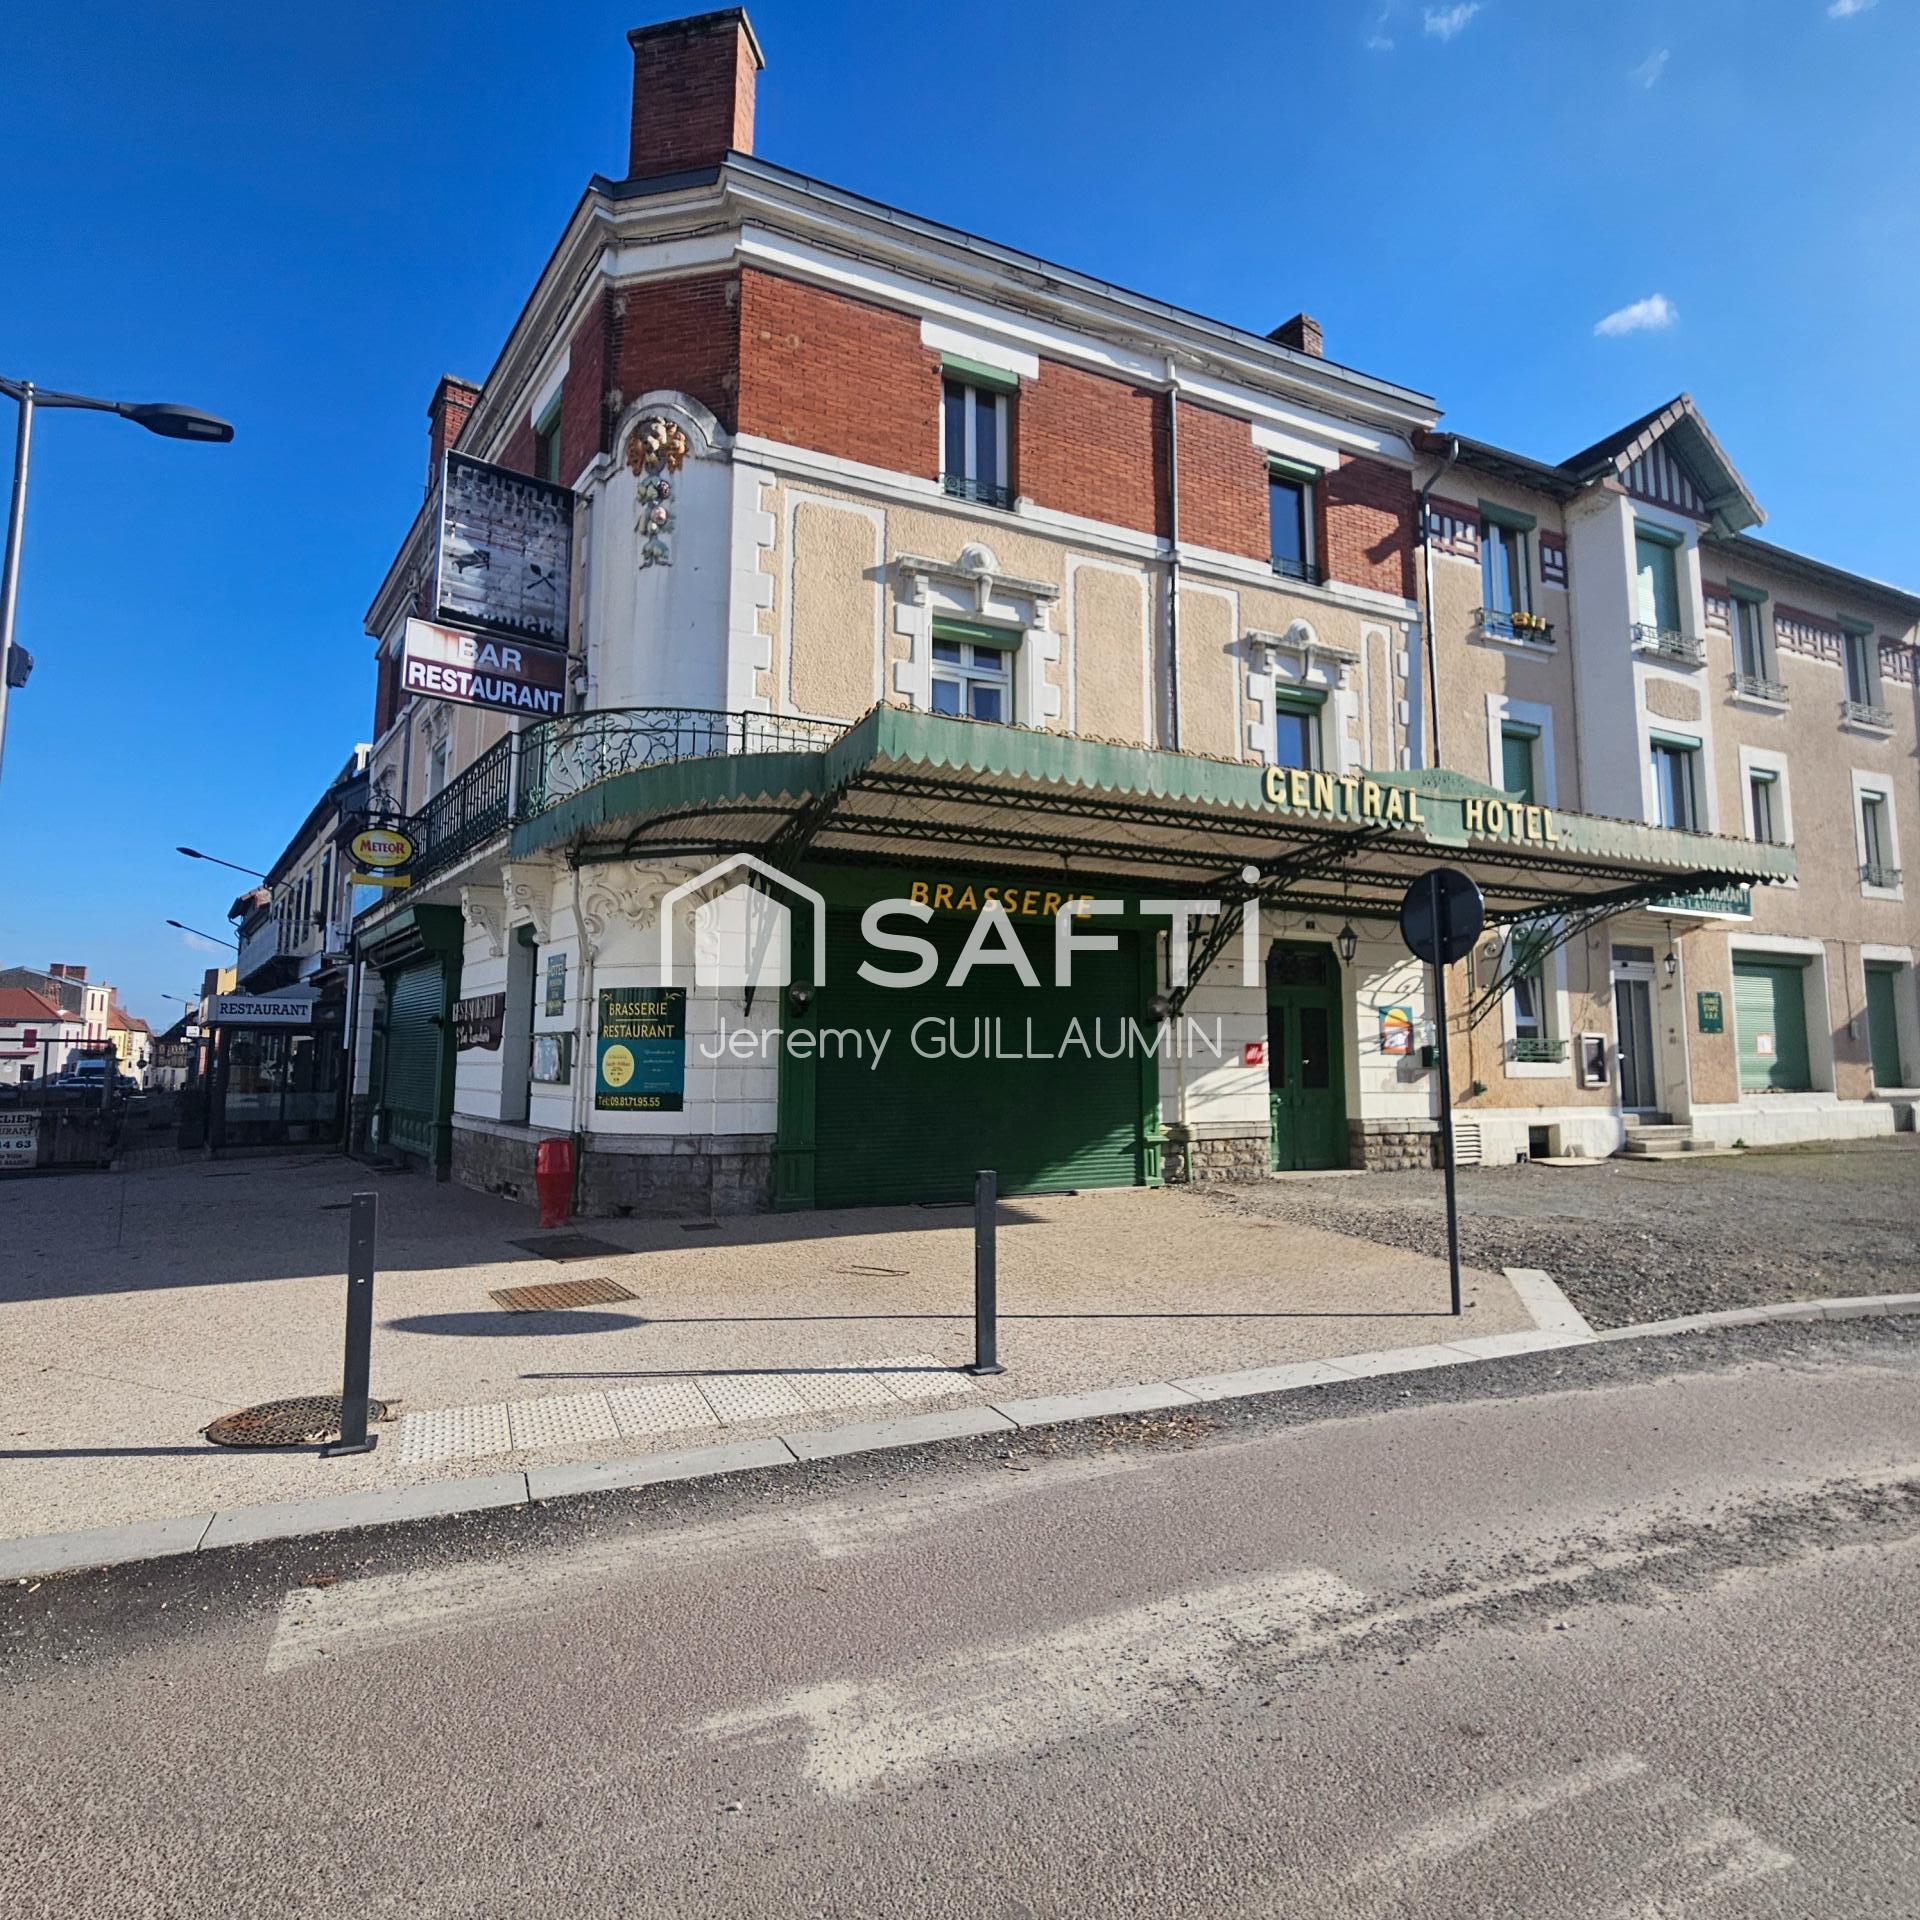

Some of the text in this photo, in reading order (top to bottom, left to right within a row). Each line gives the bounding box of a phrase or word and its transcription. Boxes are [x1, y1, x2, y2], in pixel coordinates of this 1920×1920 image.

[458, 636, 522, 672] BAR
[408, 661, 563, 713] RESTAURANT
[1265, 765, 1560, 842] CENTRAL HOTEL
[910, 881, 1096, 919] BRASSERIE
[219, 1002, 309, 1016] RESTAURANT
[608, 1001, 669, 1016] BRASSERIE
[602, 1023, 676, 1039] RESTAURANT
[15, 1140, 32, 1149] 63
